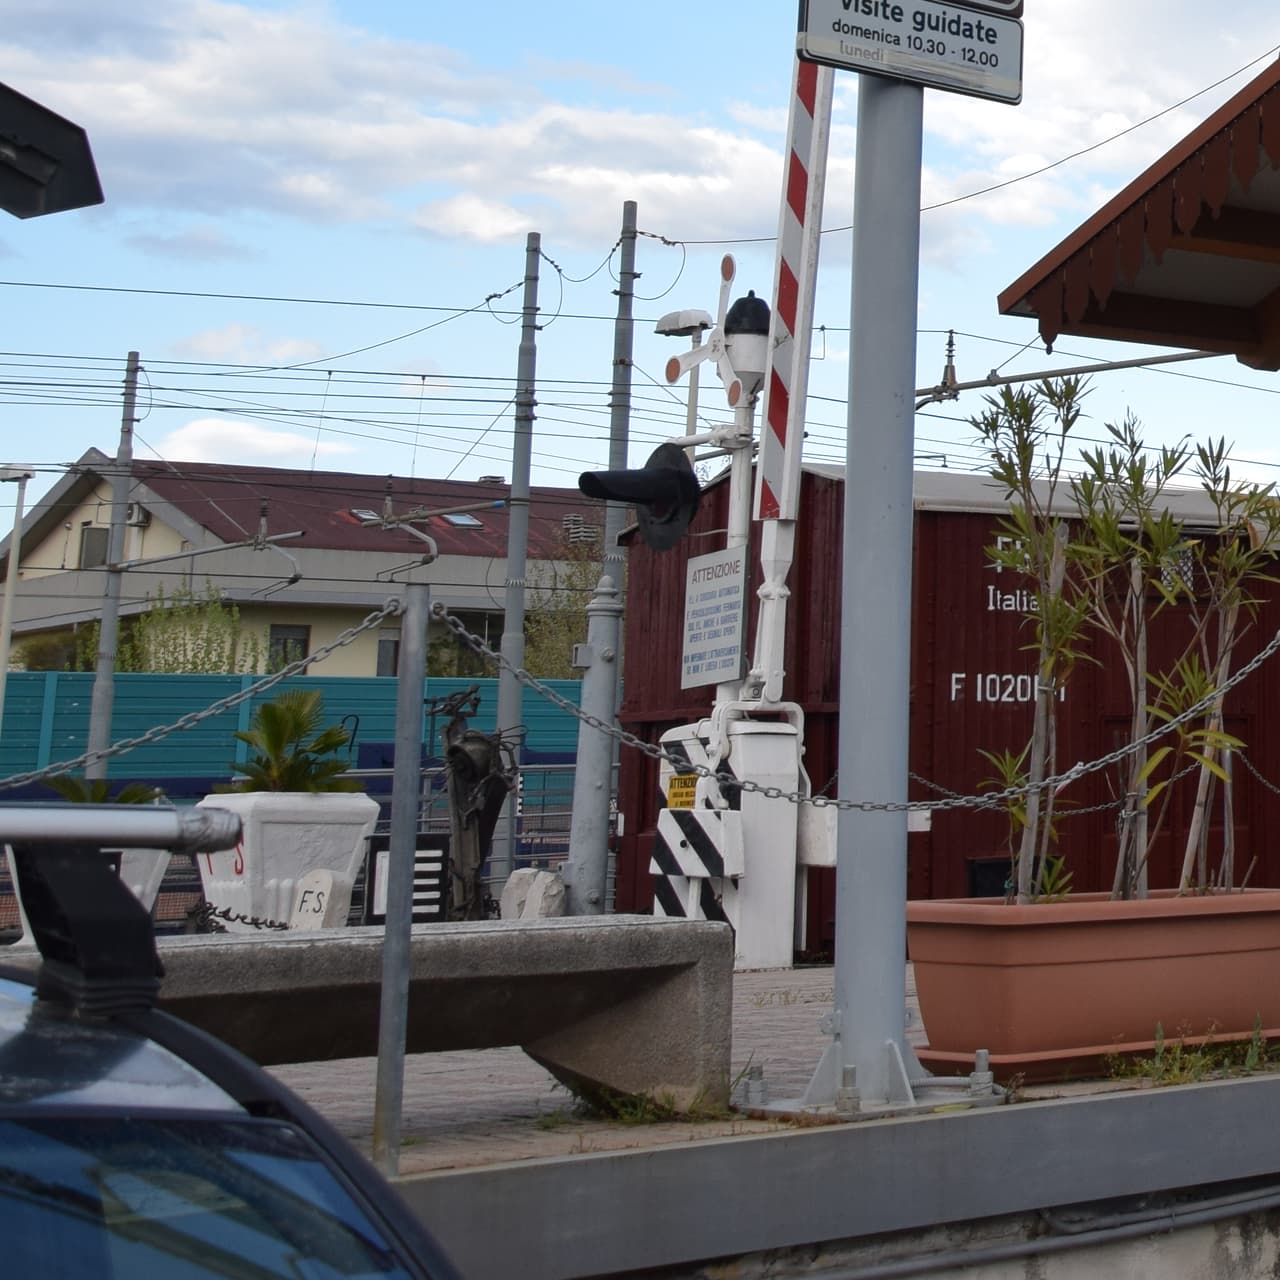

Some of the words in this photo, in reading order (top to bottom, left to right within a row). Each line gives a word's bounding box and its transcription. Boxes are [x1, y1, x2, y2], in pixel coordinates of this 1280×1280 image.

[912, 8, 998, 44] guidate
[832, 19, 901, 46] domenica
[907, 35, 946, 57] 10.30
[961, 47, 999, 68] 12.00
[692, 560, 741, 584] ATTENZIONE
[951, 673, 966, 702] F
[298, 890, 324, 914] F.S.
